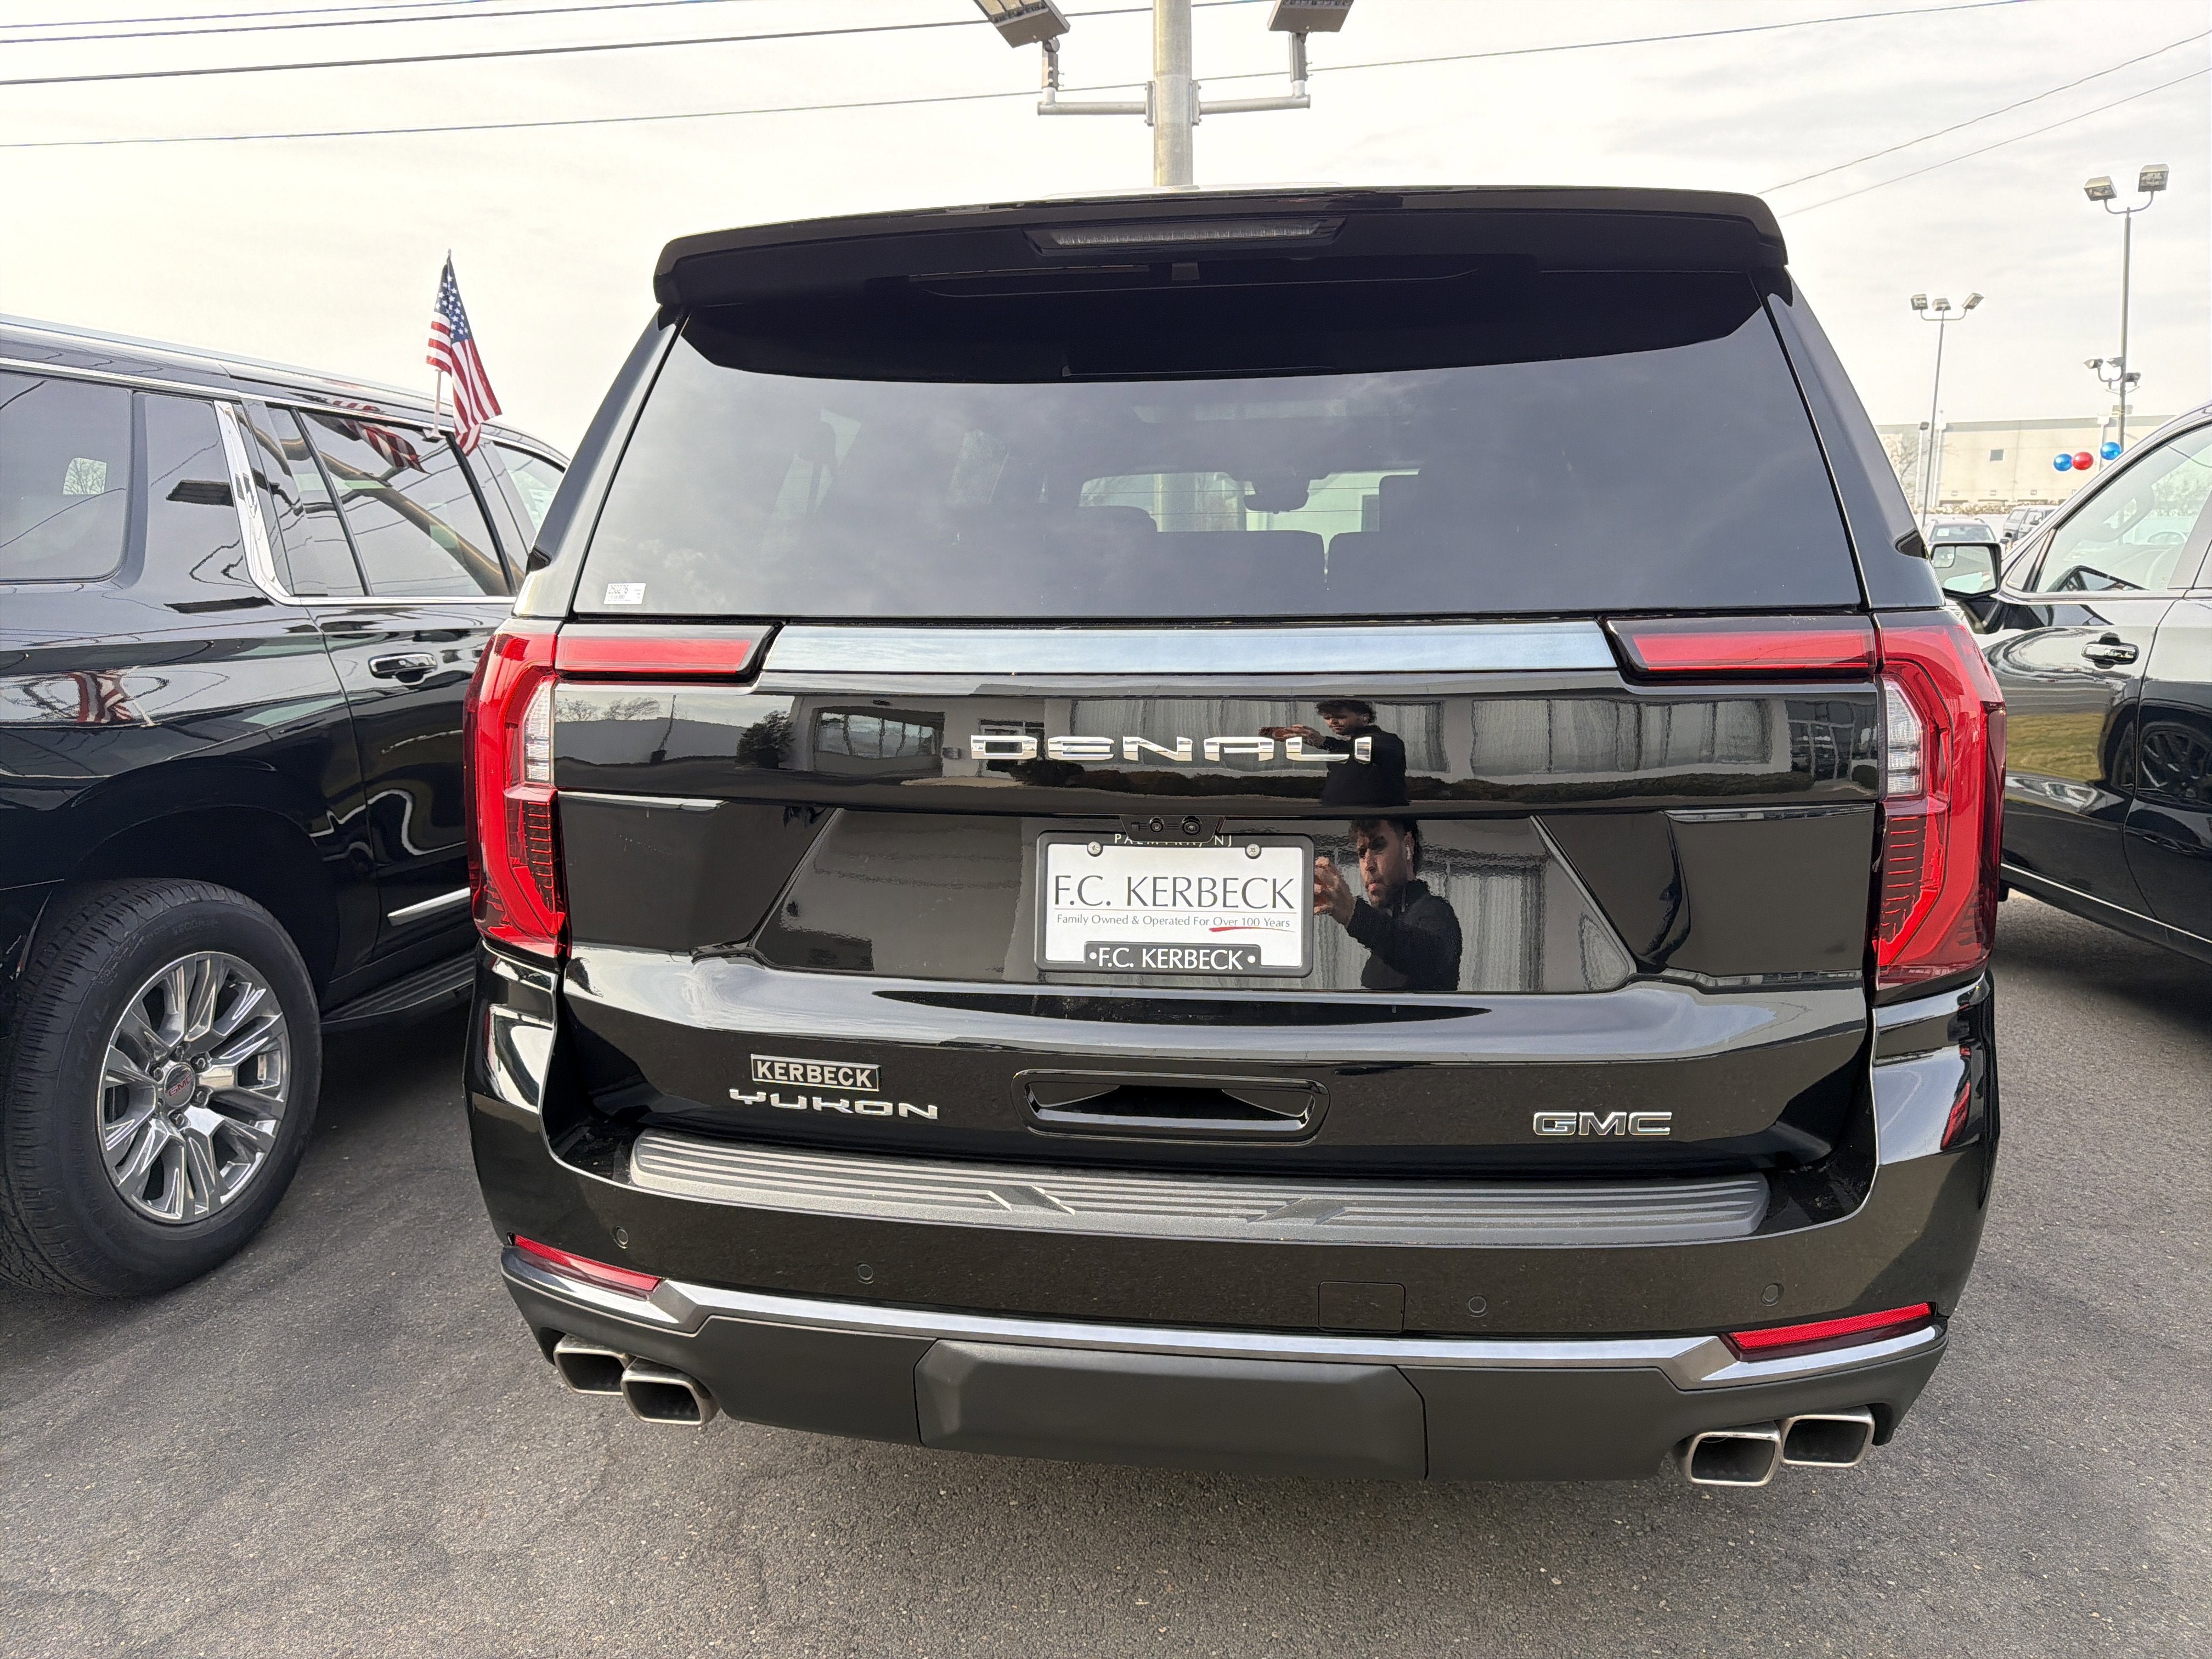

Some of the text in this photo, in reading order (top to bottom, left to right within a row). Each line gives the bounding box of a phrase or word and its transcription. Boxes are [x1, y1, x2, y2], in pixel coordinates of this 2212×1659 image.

[970, 735, 1372, 761] DENALI
[1214, 835, 1232, 847] NJ
[1054, 875, 1295, 909] F.C. KERBECK
[1057, 913, 1290, 927] Family Owned & Operated For Over 100 Years
[1098, 947, 1243, 970] F.C. KERBECK
[167, 1074, 193, 1097] GMC
[757, 1060, 872, 1087] KERBECK
[729, 1088, 938, 1120] YUKON
[1533, 1111, 1673, 1136] GMC
